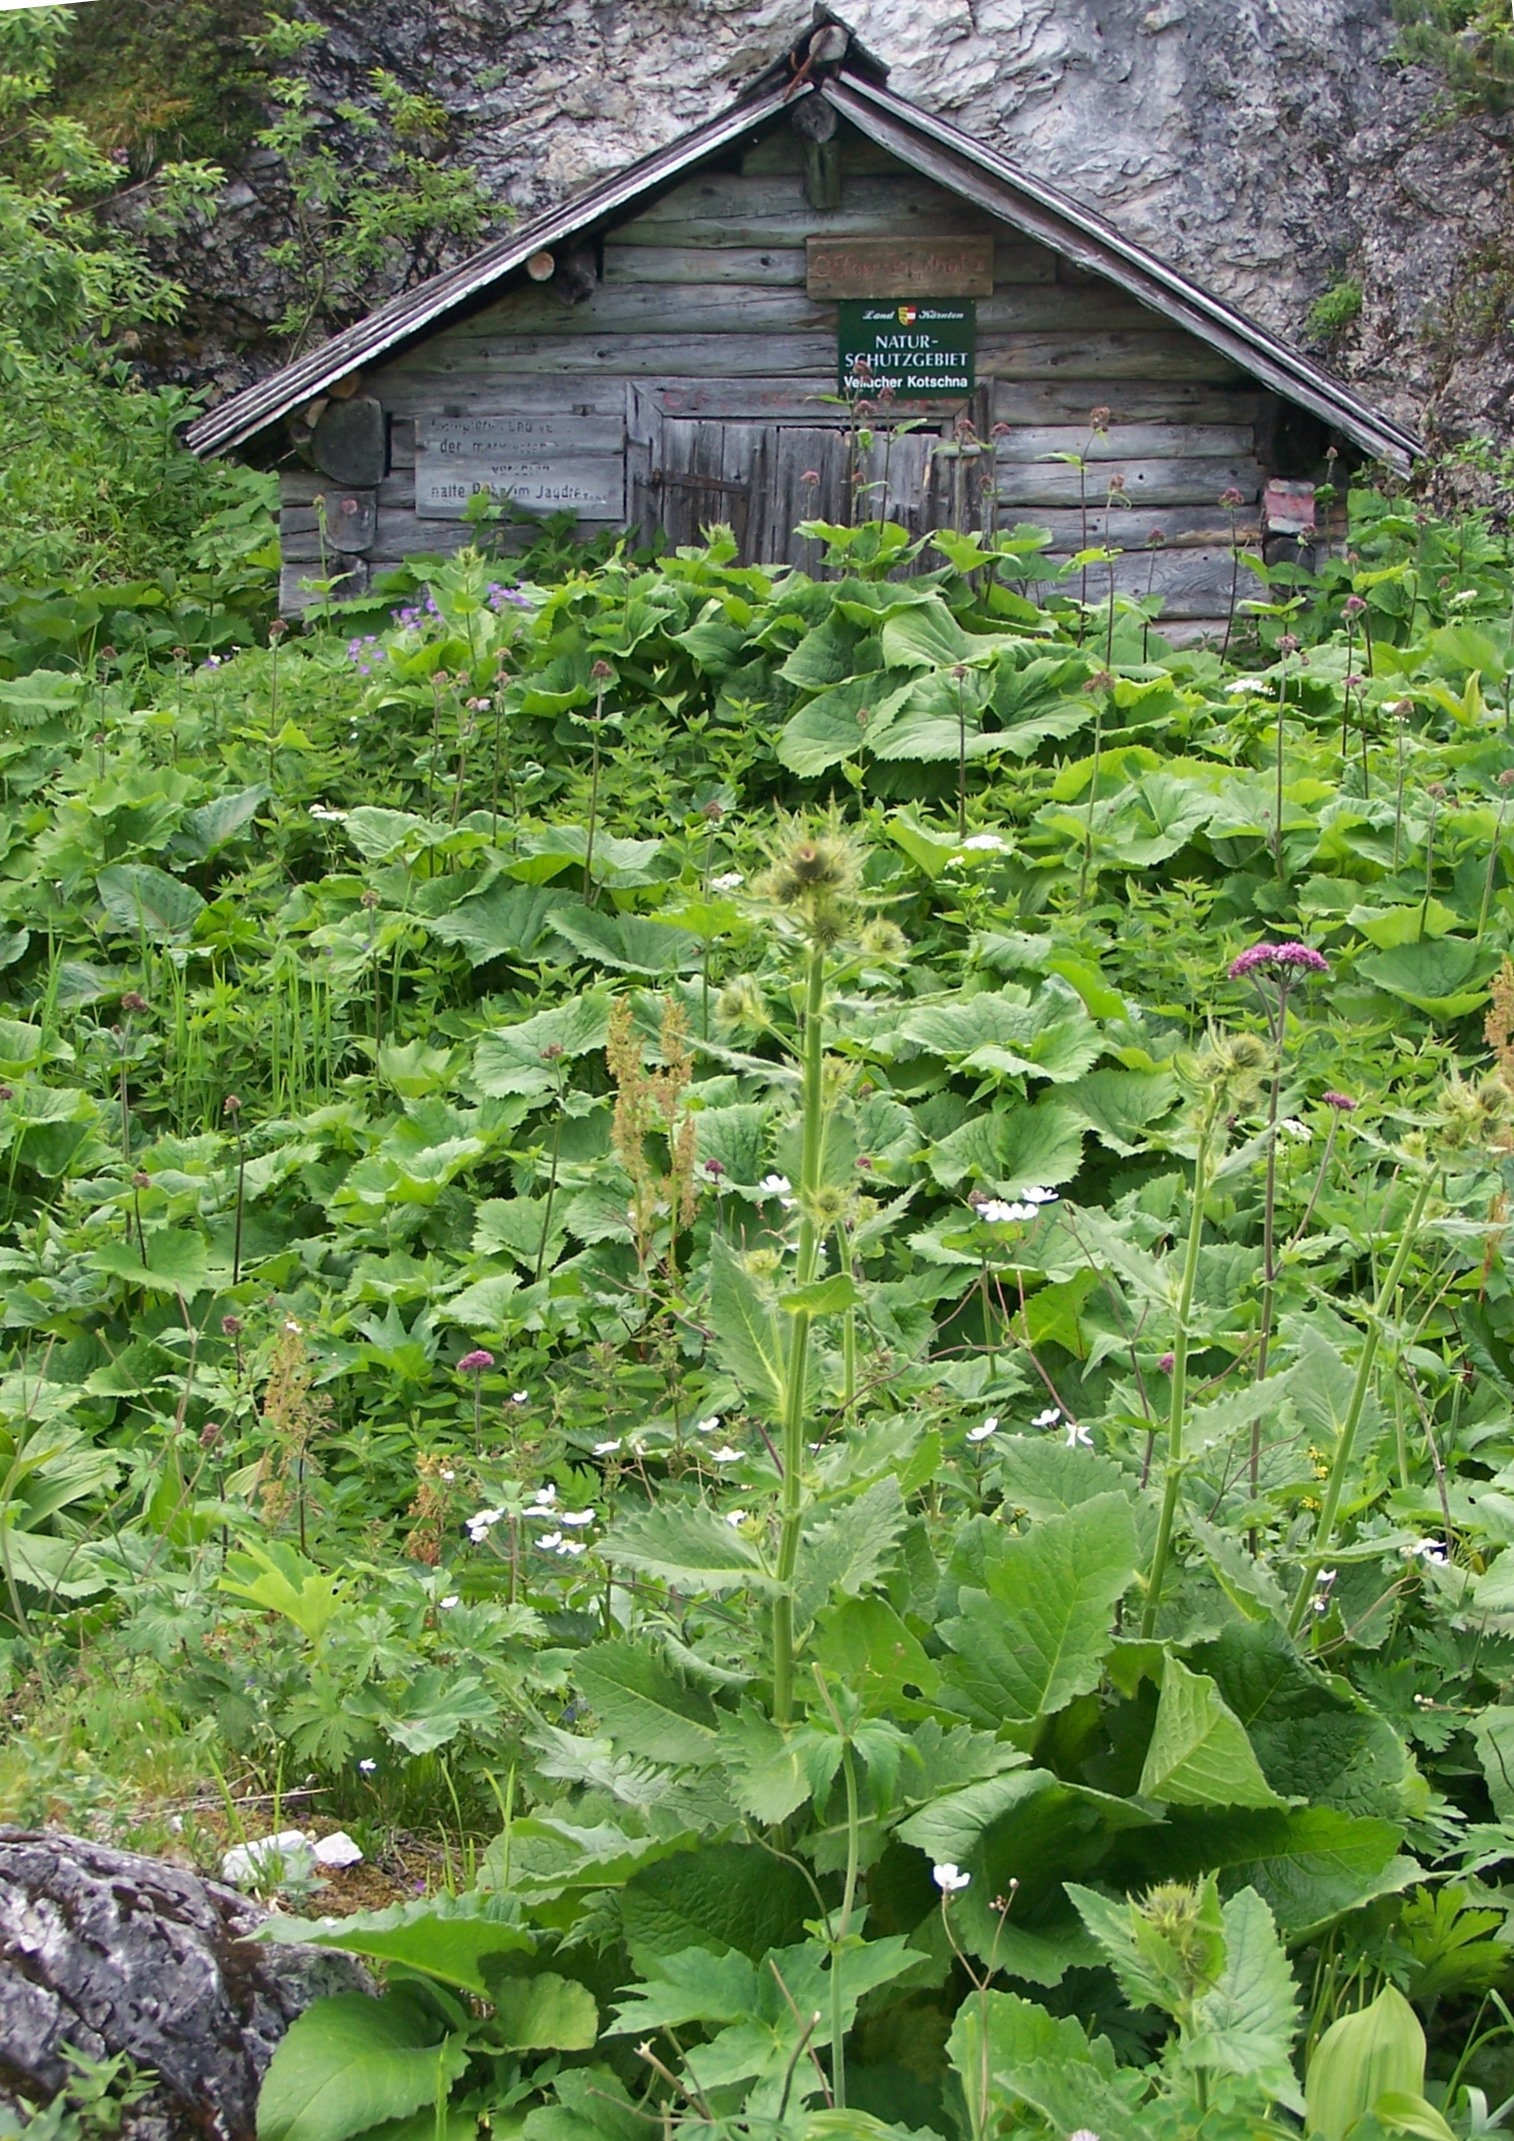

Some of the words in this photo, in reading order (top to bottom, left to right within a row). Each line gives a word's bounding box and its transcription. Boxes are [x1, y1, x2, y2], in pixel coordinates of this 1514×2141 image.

[863, 310, 895, 320] Land
[918, 309, 964, 320] Kärnten
[875, 335, 939, 349] NATUR-
[845, 353, 968, 367] SCHUTZGEBIET
[907, 375, 968, 388] Kotschna
[440, 439, 461, 453] der
